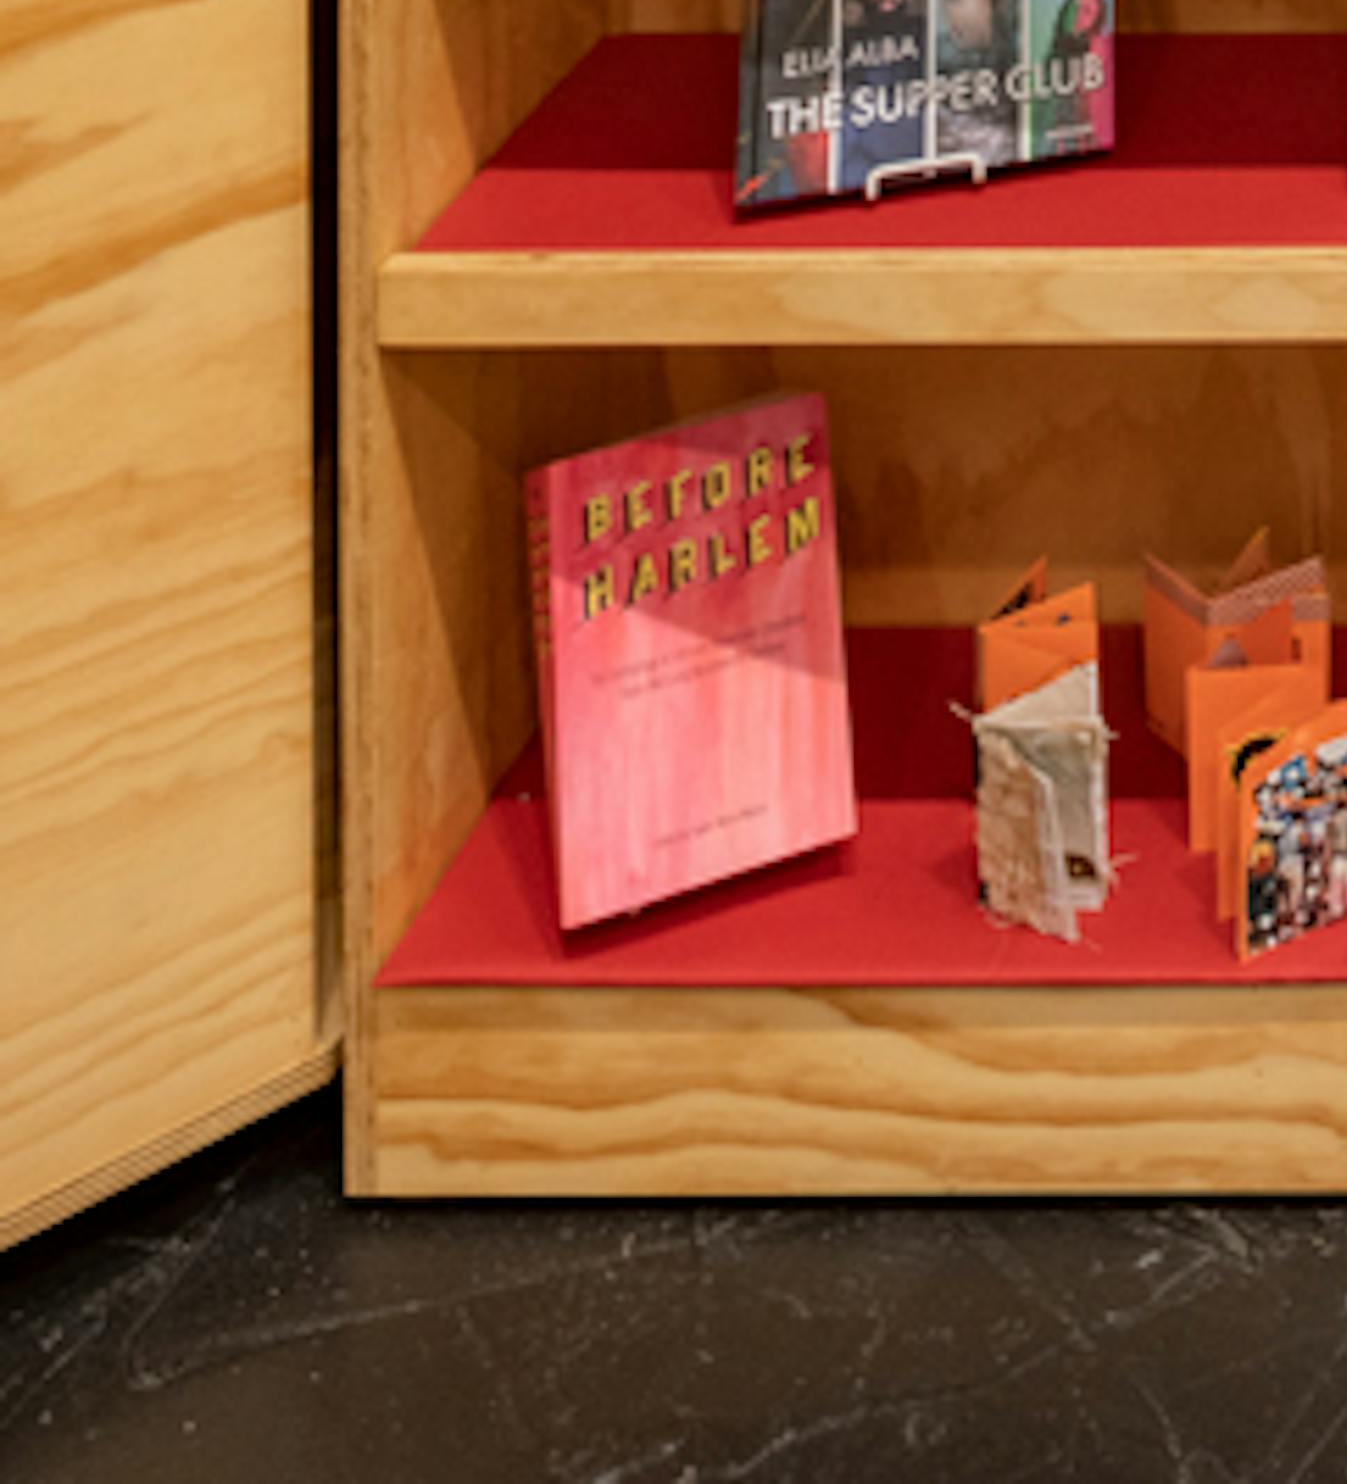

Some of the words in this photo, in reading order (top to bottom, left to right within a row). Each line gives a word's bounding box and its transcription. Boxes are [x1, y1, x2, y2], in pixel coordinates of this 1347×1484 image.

[766, 88, 843, 139] THE
[850, 68, 999, 128] SUPPER
[1005, 54, 1105, 103] CLUB
[844, 33, 920, 69] ALBA
[582, 432, 819, 546] BEFORE
[581, 494, 821, 623] HARLEM
